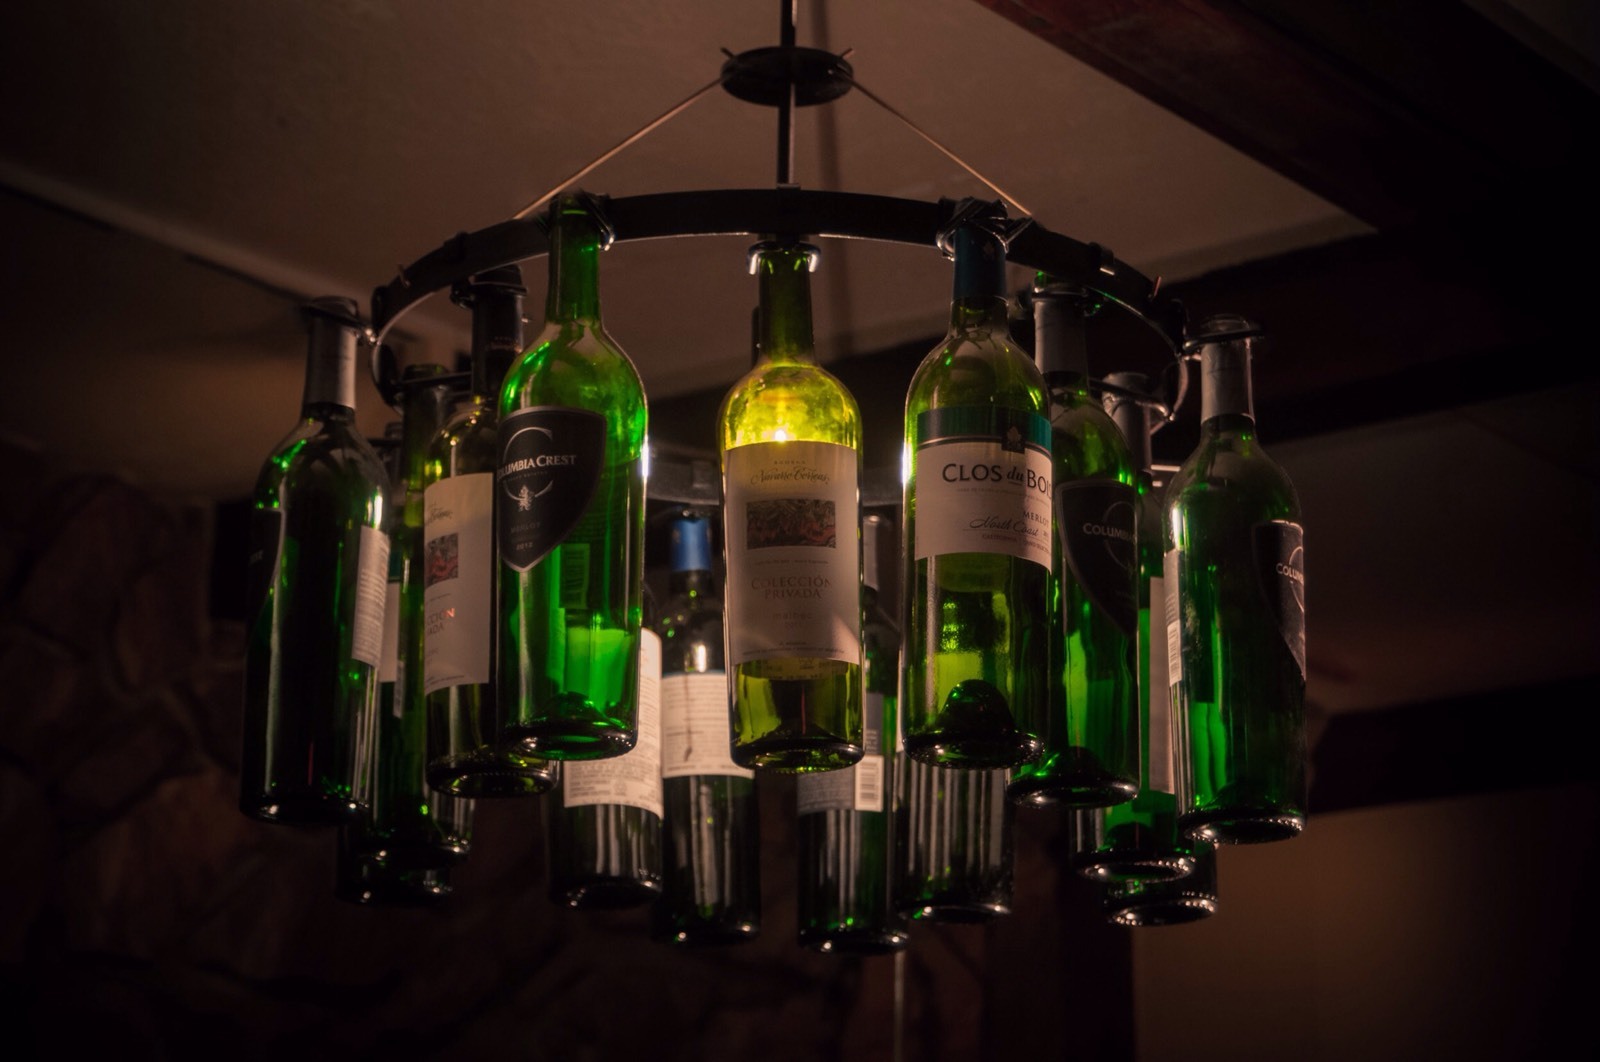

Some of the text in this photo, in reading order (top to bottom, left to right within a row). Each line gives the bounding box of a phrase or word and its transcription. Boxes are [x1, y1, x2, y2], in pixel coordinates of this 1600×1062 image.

[536, 454, 576, 468] CREST
[942, 463, 1003, 482] CLOS
[1006, 466, 1024, 482] du
[751, 575, 832, 590] COLECCIÓN
[765, 588, 823, 601] PRIVADA
